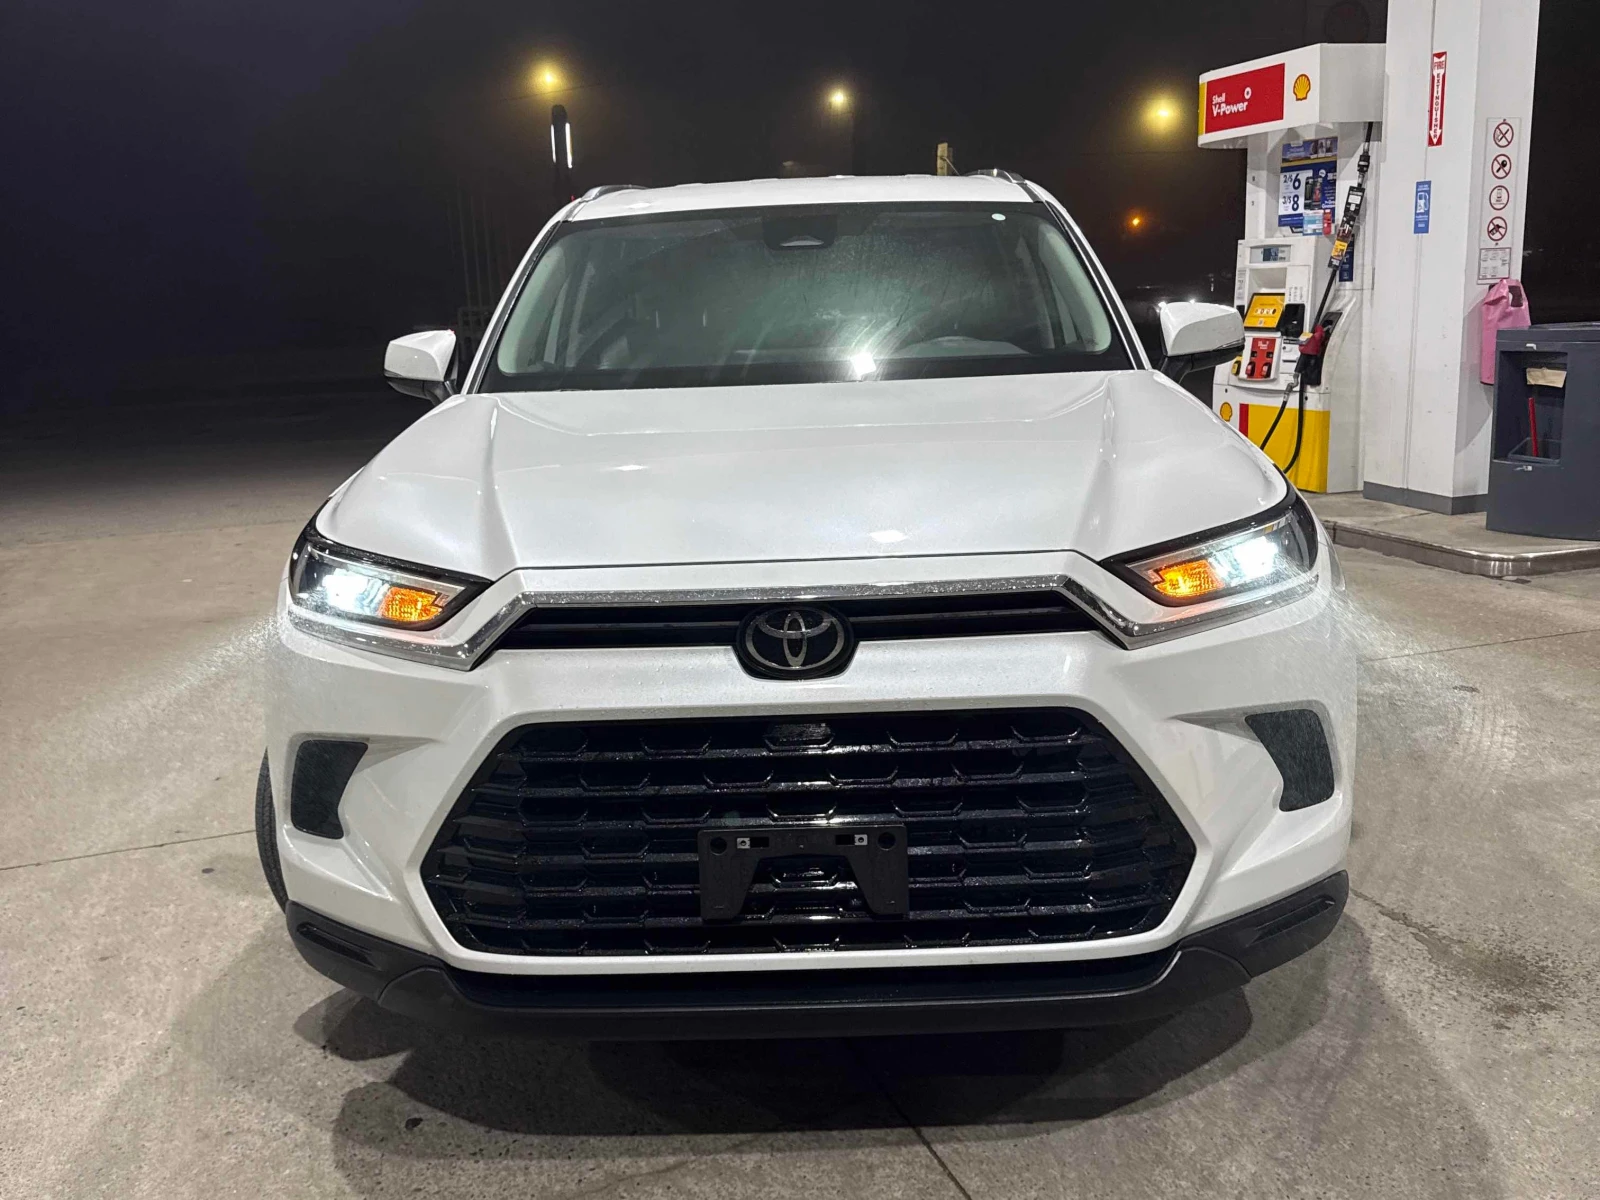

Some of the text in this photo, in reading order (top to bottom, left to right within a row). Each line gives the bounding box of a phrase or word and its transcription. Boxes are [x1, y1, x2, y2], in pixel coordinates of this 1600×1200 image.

[1433, 60, 1445, 70] FIRE
[1212, 93, 1226, 105] Shell
[1433, 72, 1441, 139] EXTINGUISHER
[1212, 101, 1248, 117] V-Power
